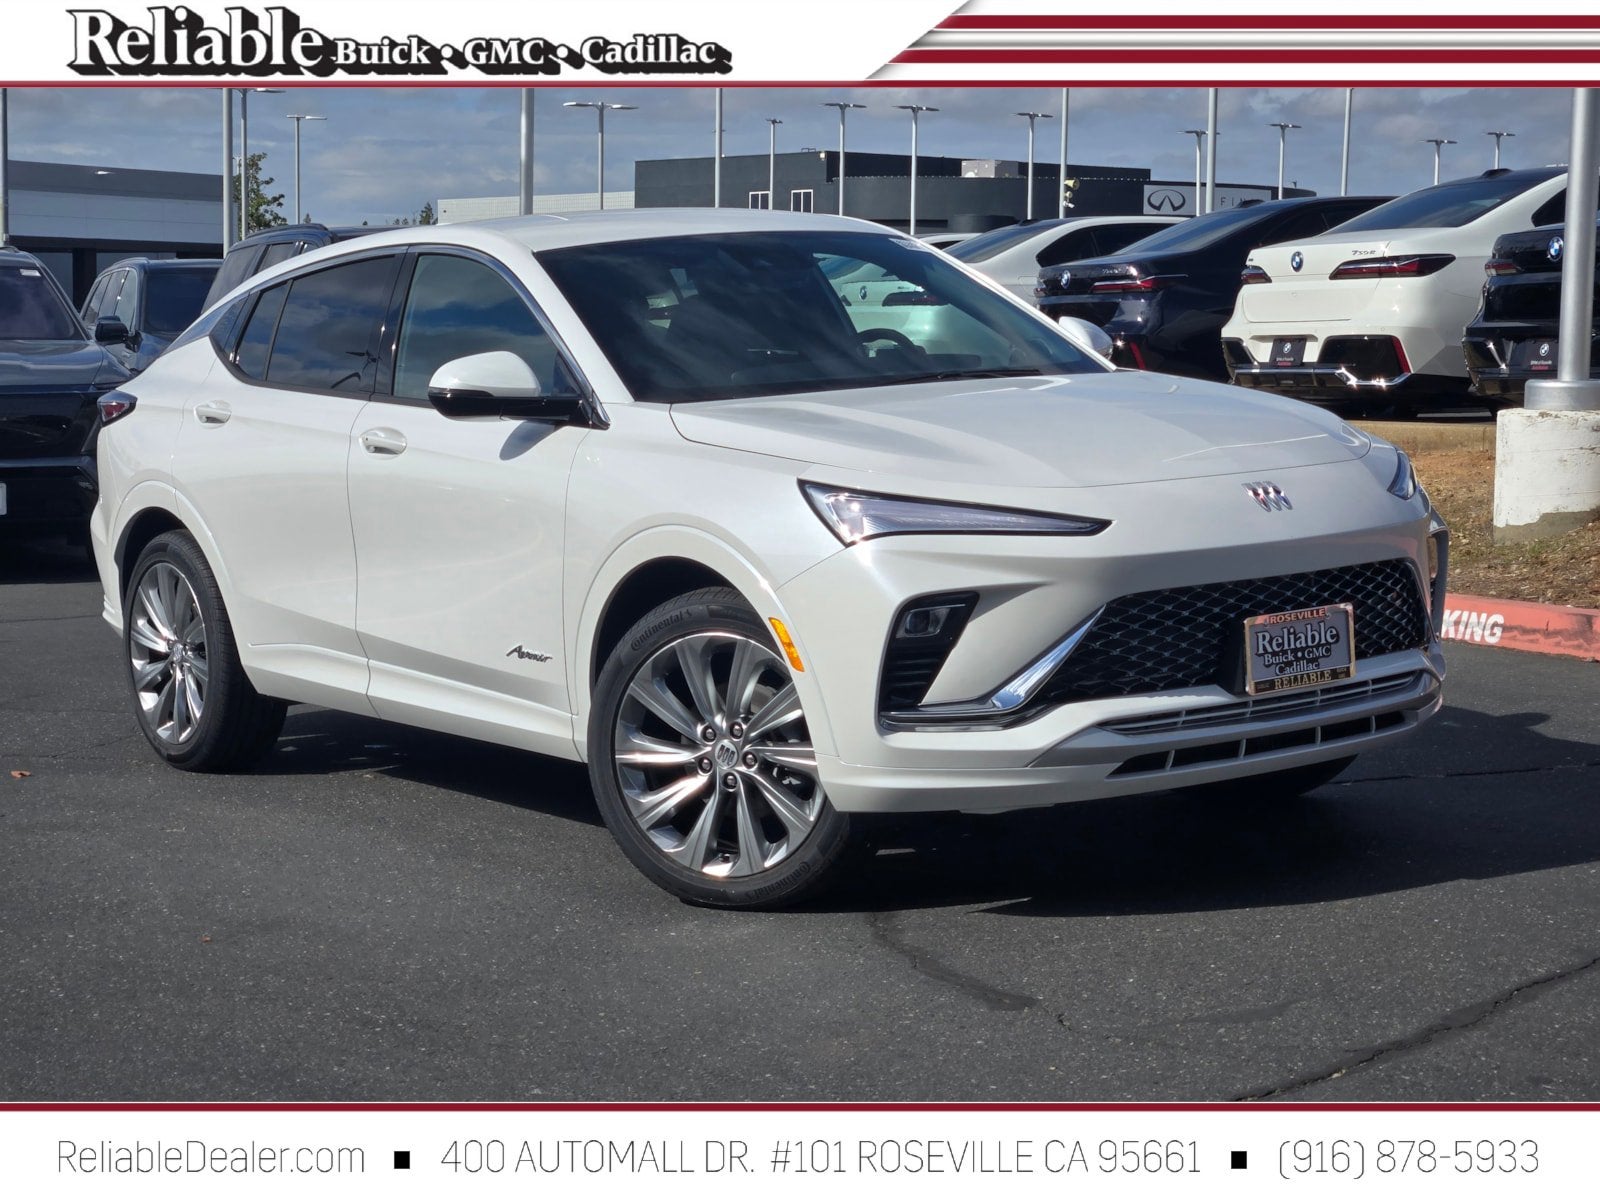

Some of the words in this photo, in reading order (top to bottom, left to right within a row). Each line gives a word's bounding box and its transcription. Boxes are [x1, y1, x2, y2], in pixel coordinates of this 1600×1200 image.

[1270, 608, 1326, 625] ROSEVILLE
[1441, 609, 1504, 644] KING
[631, 611, 683, 651] Continental
[1257, 622, 1338, 654] Reliable
[1264, 650, 1295, 665] Buick
[1304, 645, 1331, 659] GMC
[1275, 661, 1319, 676] Cadillac
[1274, 670, 1332, 690] RELIABLE
